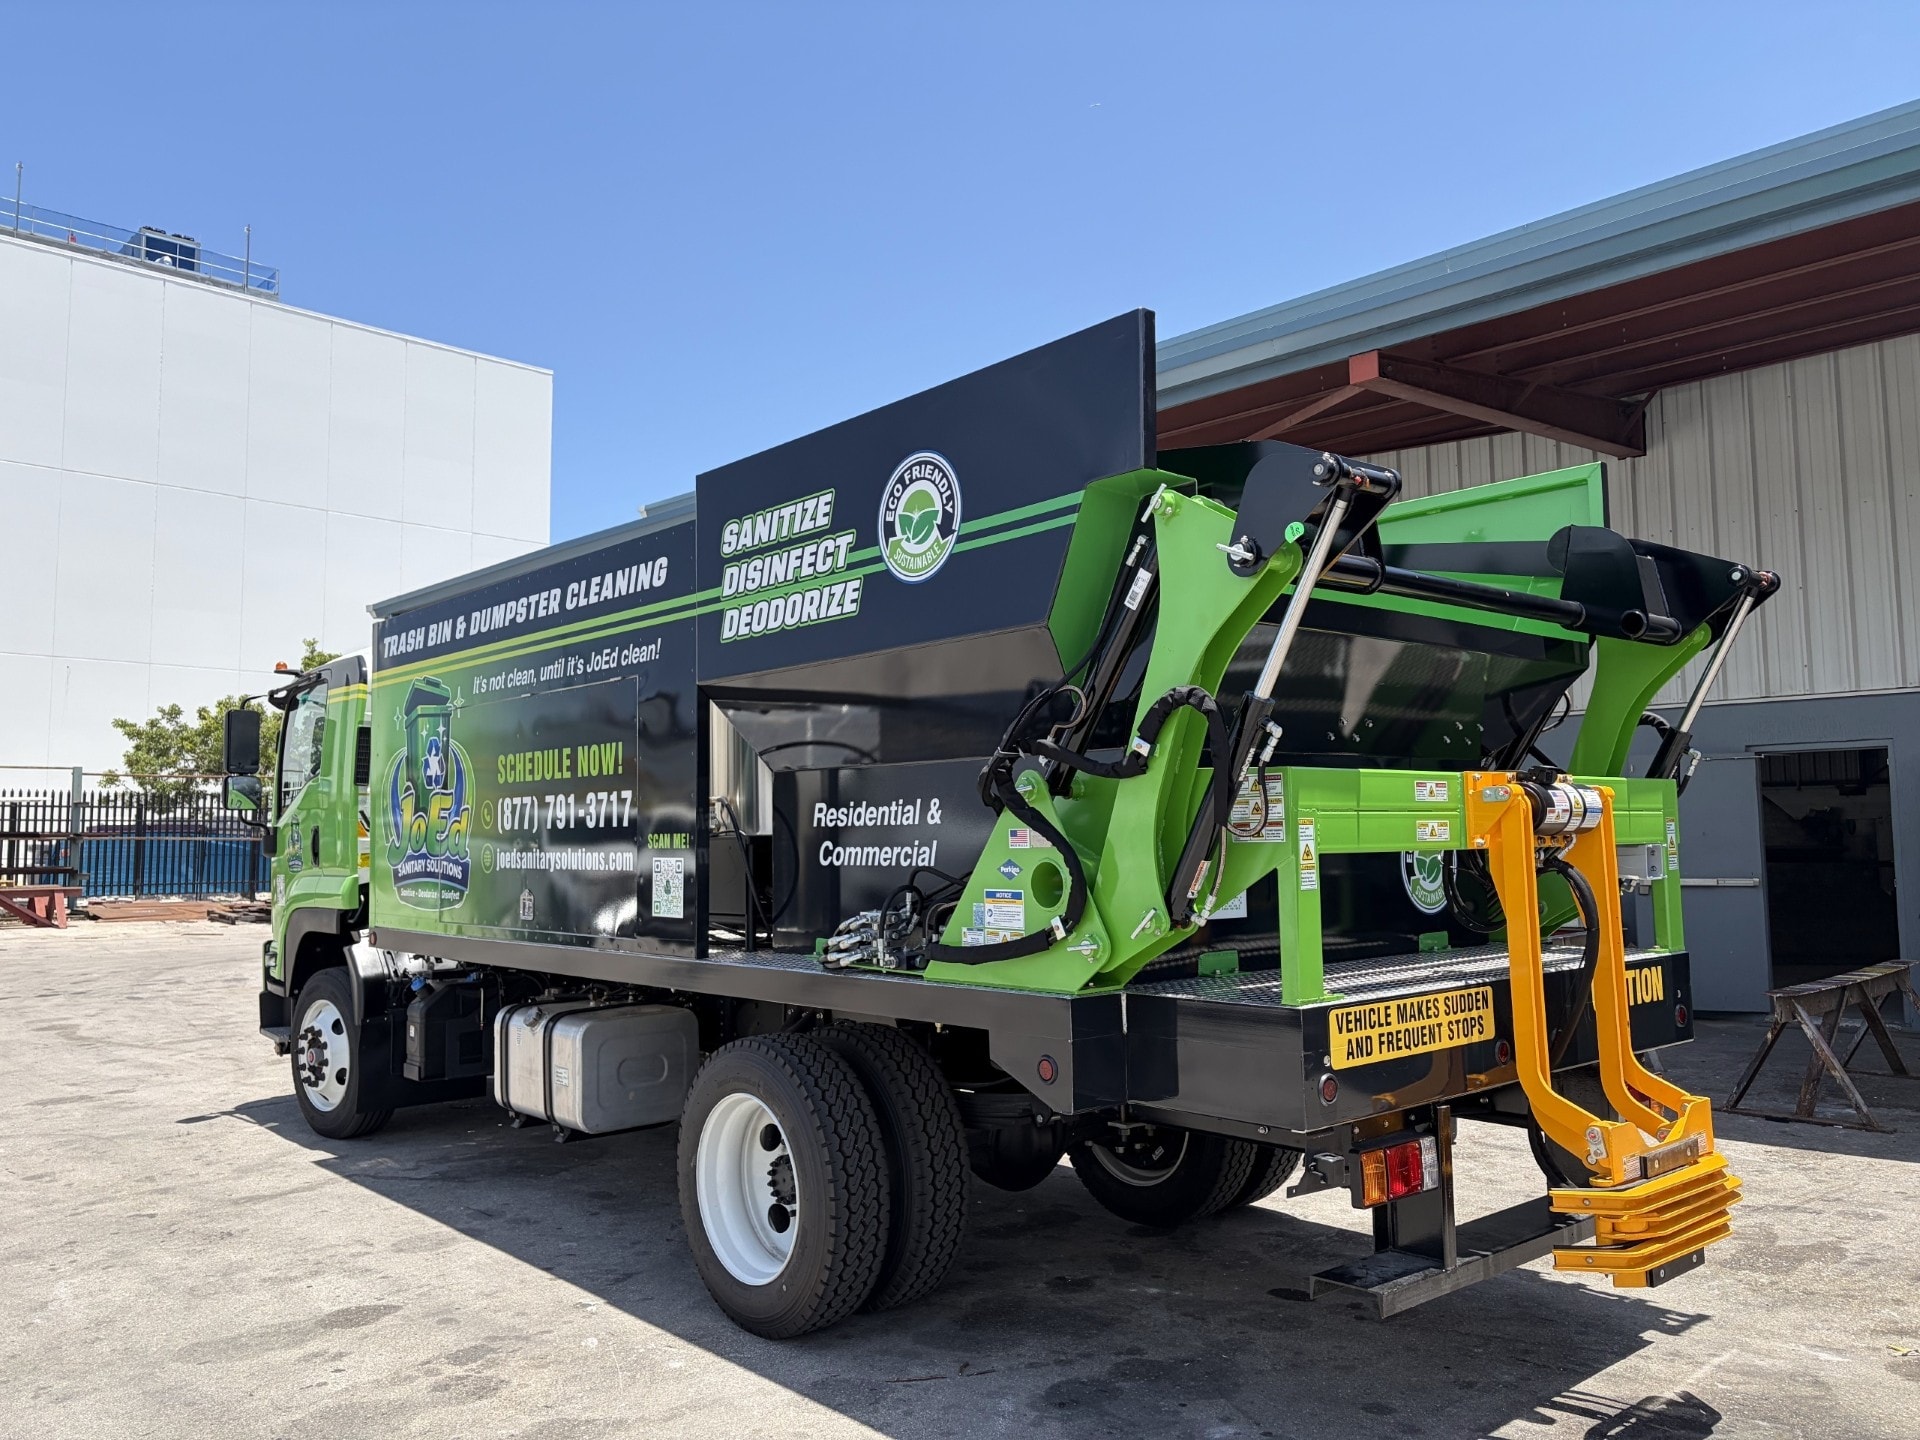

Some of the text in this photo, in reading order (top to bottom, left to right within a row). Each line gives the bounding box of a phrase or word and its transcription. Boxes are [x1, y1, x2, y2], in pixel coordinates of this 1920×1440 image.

[885, 463, 955, 522] ECO FRIENDLY
[722, 491, 833, 554] SANITIZE
[722, 534, 854, 597] DISINFECT
[892, 541, 941, 570] SUSTAINABLE
[383, 556, 669, 659] TRASH BIN & DUMPSTER CLEANING
[722, 579, 861, 640] DEODORIZE
[472, 637, 662, 695] It's not clean, until it's JoEd clean!
[497, 741, 624, 784] SCHEDULE NOW!
[389, 789, 469, 864] JoEd
[497, 789, 633, 835] (877) 791-3717
[813, 797, 942, 828] Residential &
[496, 848, 634, 873] joedsanitarysolutions.com
[647, 832, 690, 849] SCAN ME!
[819, 840, 938, 867] Commercial
[398, 859, 463, 880] SANITARY SOLUTIONS
[1623, 965, 1664, 1007] TION
[1335, 989, 1490, 1035] VEHICLE MAKES SUDDEN
[1346, 1016, 1485, 1061] AND FREQUENT STOPS
